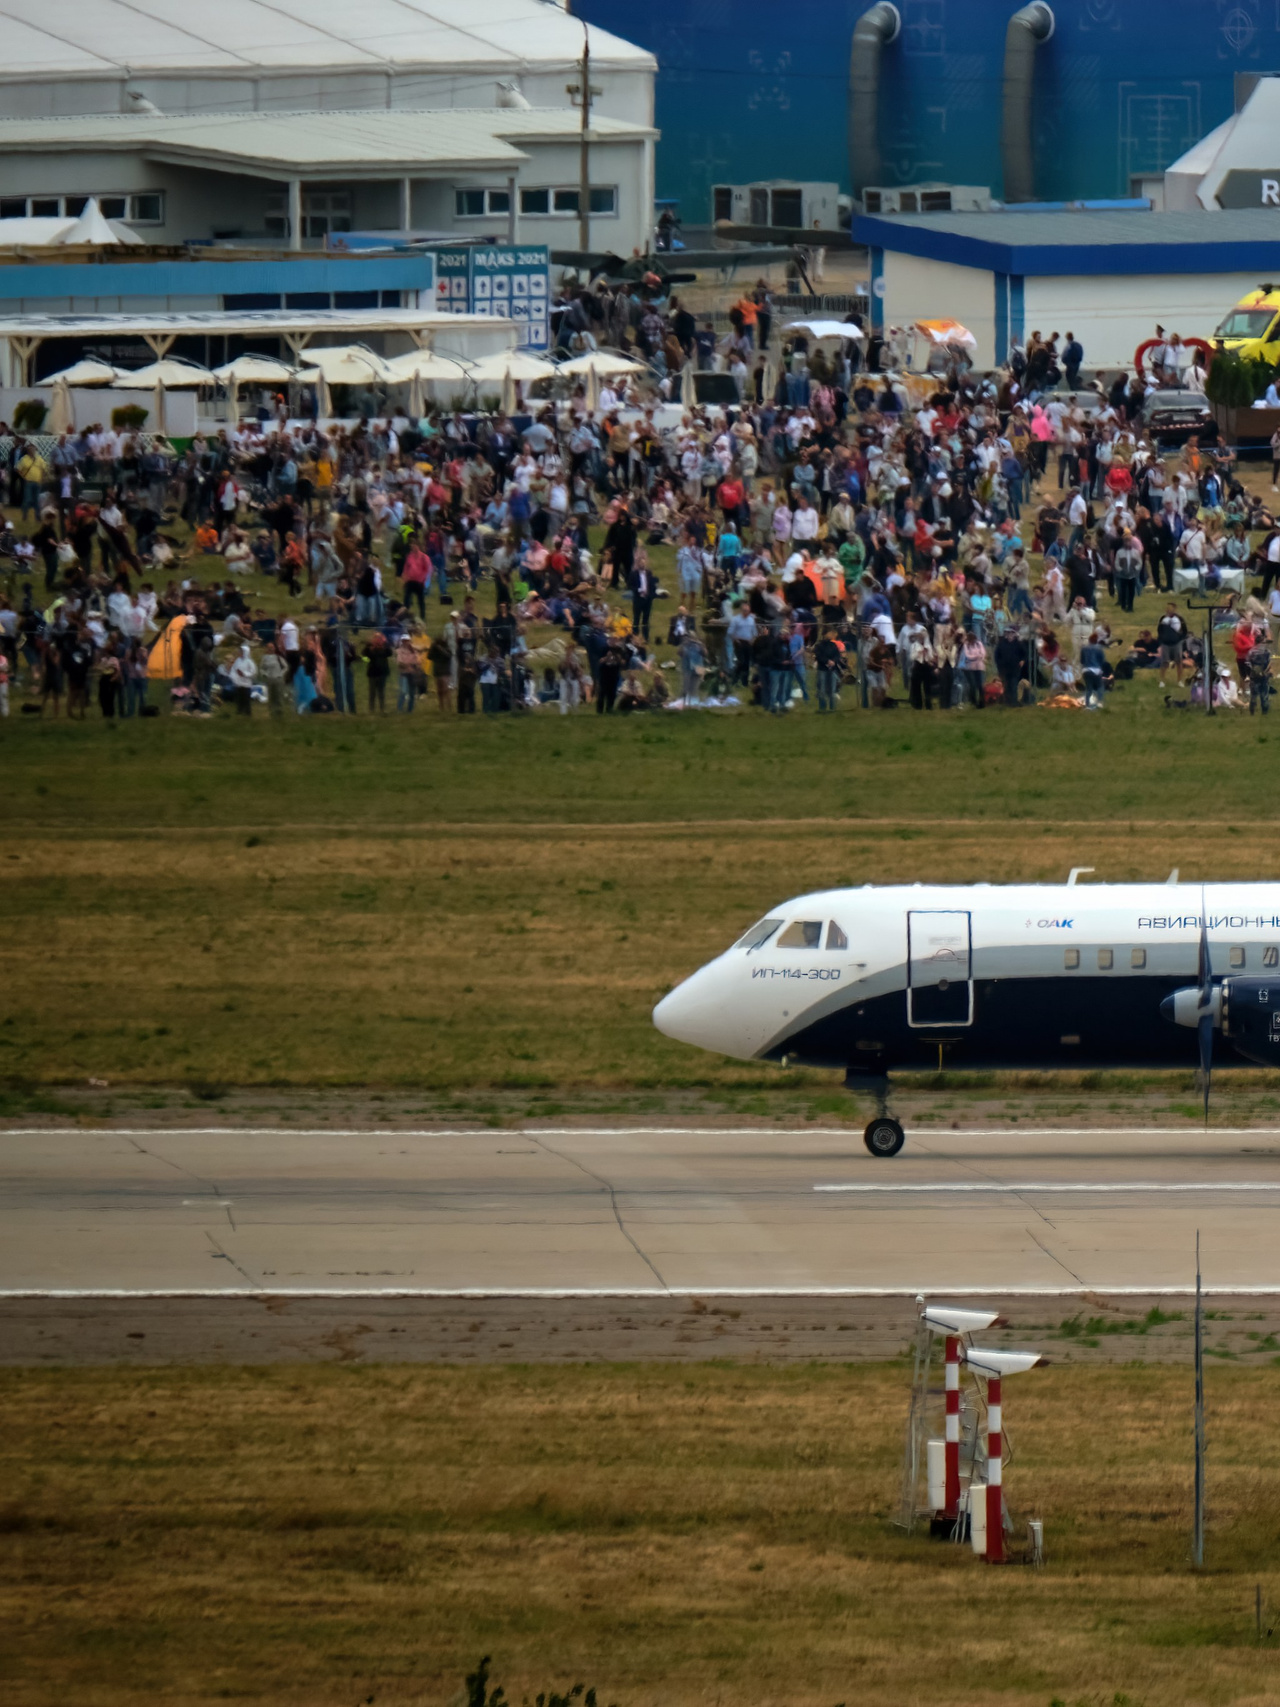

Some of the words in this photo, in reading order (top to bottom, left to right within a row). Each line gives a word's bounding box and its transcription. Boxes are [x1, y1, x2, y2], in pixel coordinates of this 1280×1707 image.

[475, 252, 516, 268] MAKS
[518, 252, 547, 266] 2021
[1037, 919, 1075, 929] ОАК
